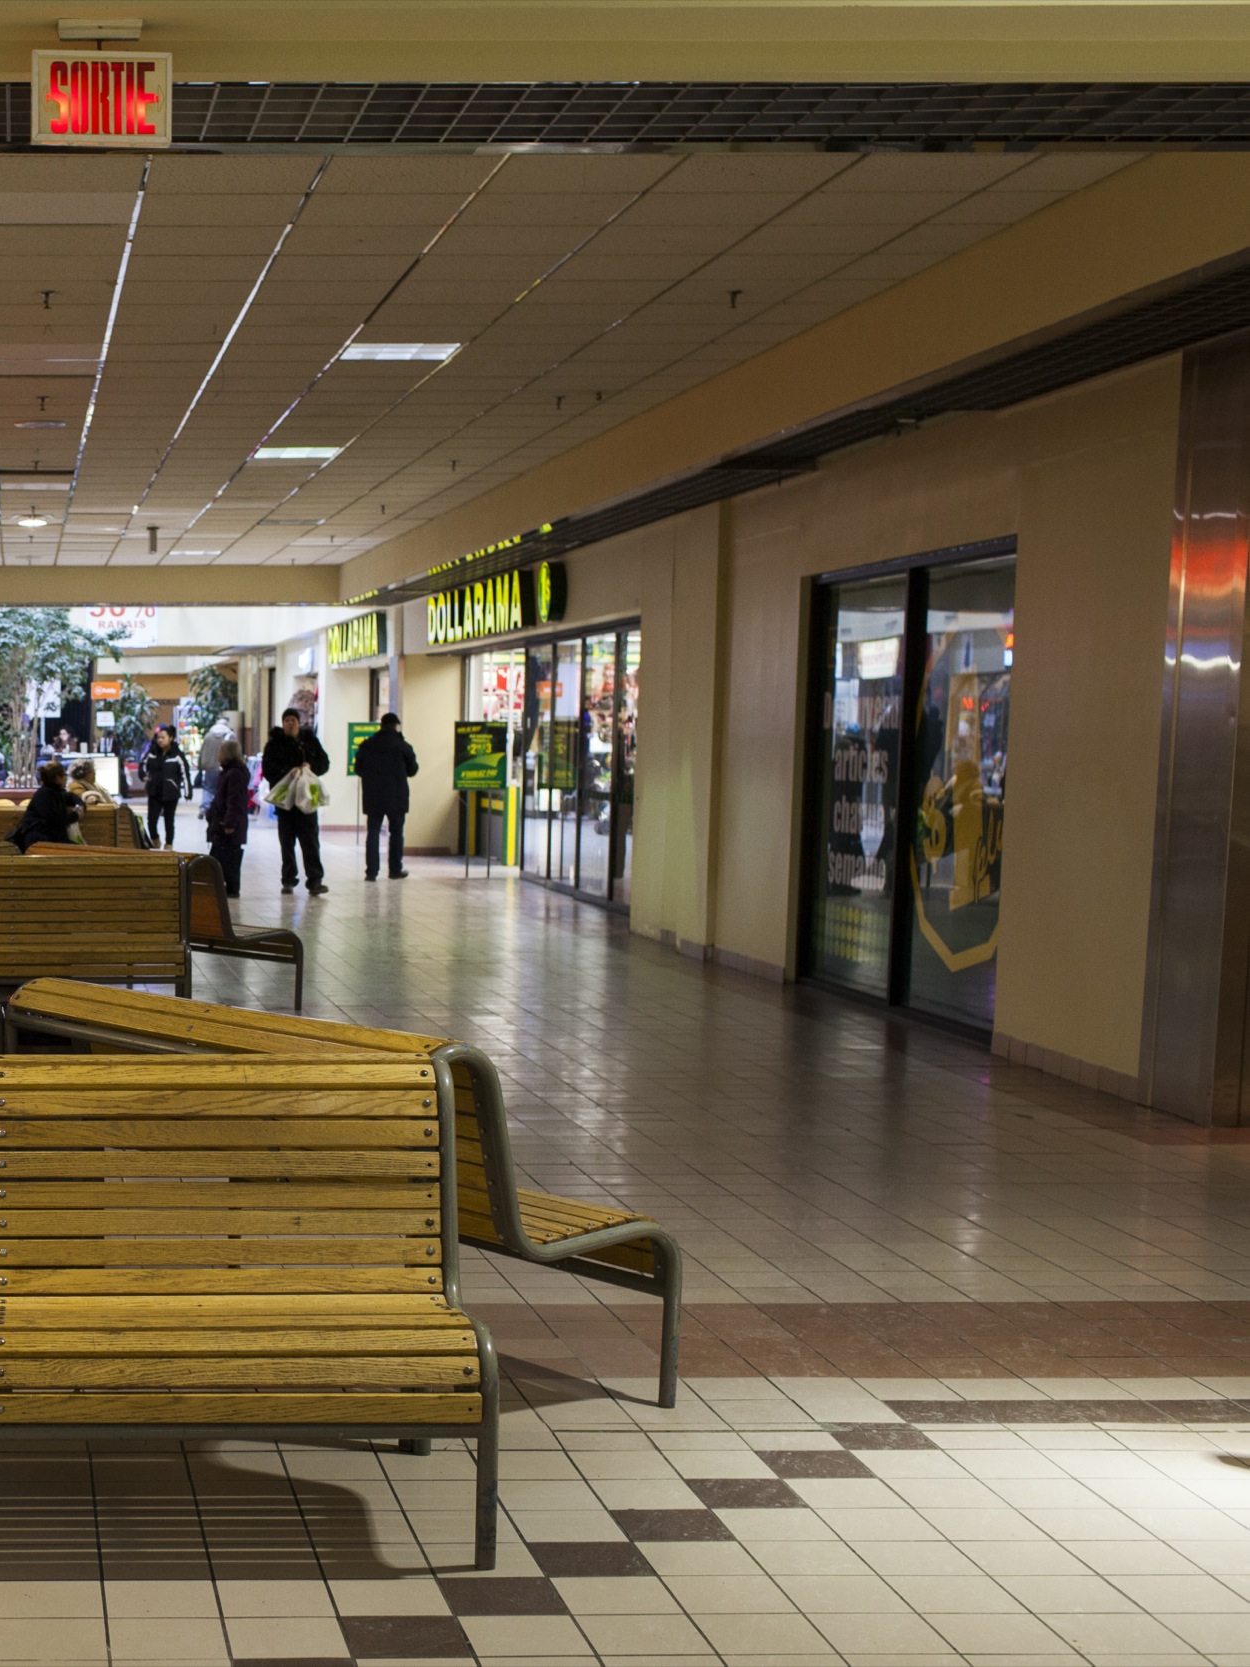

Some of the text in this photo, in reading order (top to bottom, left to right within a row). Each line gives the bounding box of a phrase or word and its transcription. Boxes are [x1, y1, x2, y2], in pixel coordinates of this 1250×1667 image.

[49, 61, 156, 135] SORTIE
[327, 611, 379, 665] DOLLARAMA
[427, 569, 523, 646] DOLLARAMA
[833, 746, 889, 785] articles
